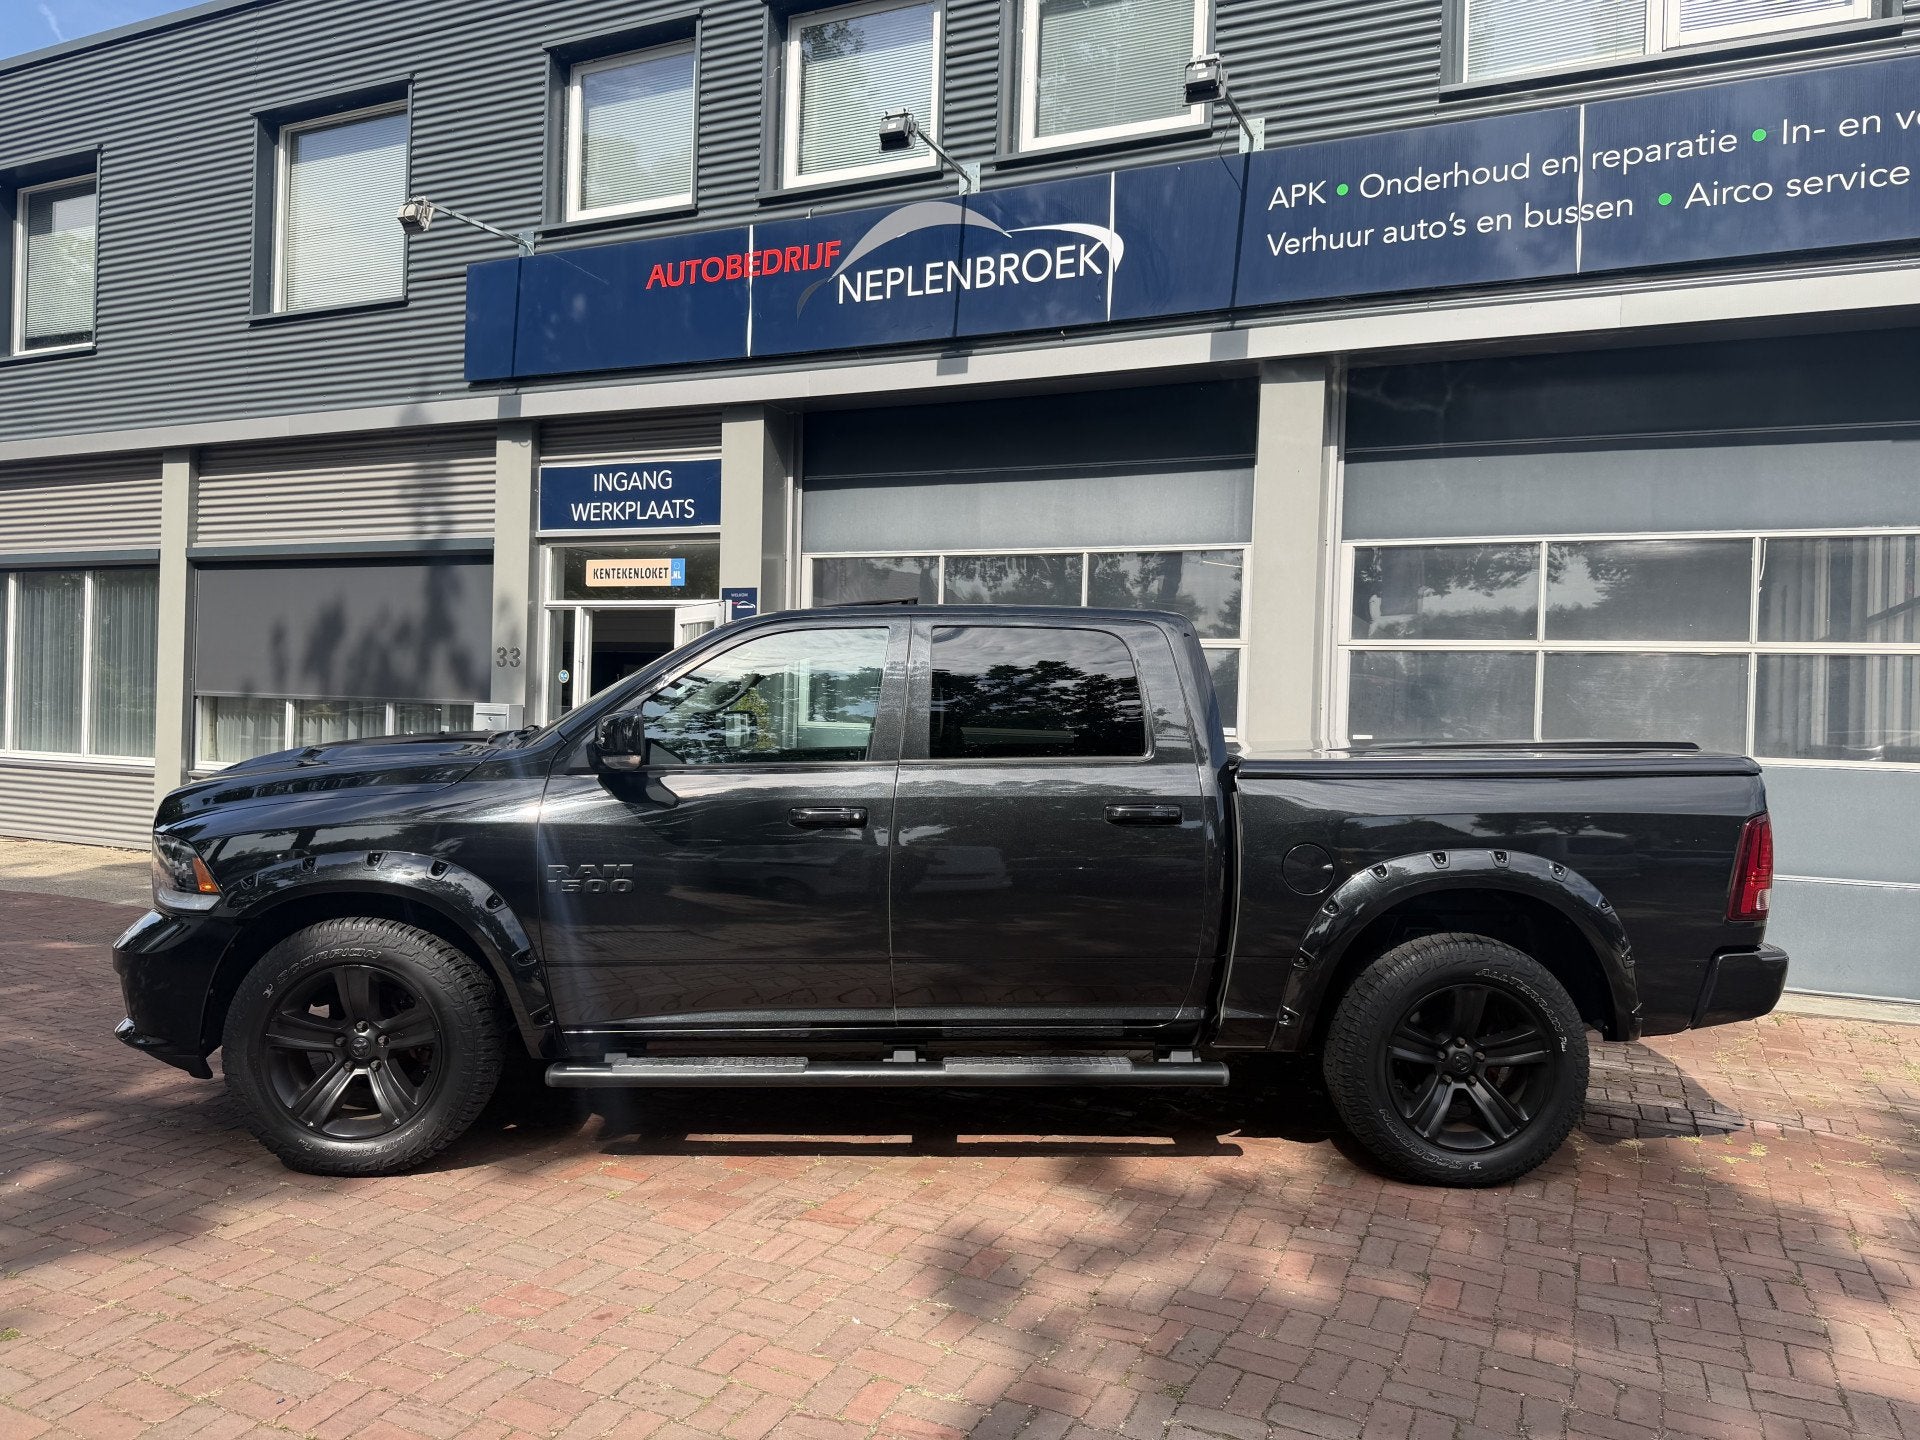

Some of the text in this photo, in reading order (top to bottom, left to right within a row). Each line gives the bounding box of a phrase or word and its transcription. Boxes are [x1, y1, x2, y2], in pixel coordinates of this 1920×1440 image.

[1268, 110, 1920, 210] APK Onderhoud en reparatie In- en v
[1266, 226, 1375, 256] Verhuur
[1477, 214, 1512, 234] en
[1525, 197, 1633, 229] bussen
[1684, 181, 1774, 210] Airco
[1785, 163, 1911, 198] service
[646, 240, 842, 290] AUTOBEDRIJF
[837, 241, 1104, 305] NEPLENBROEK
[593, 470, 673, 492] INGANG
[571, 499, 695, 522] WERKPLAATS
[496, 646, 521, 667] 33
[547, 863, 635, 878] RAM
[547, 878, 635, 894] 1500
